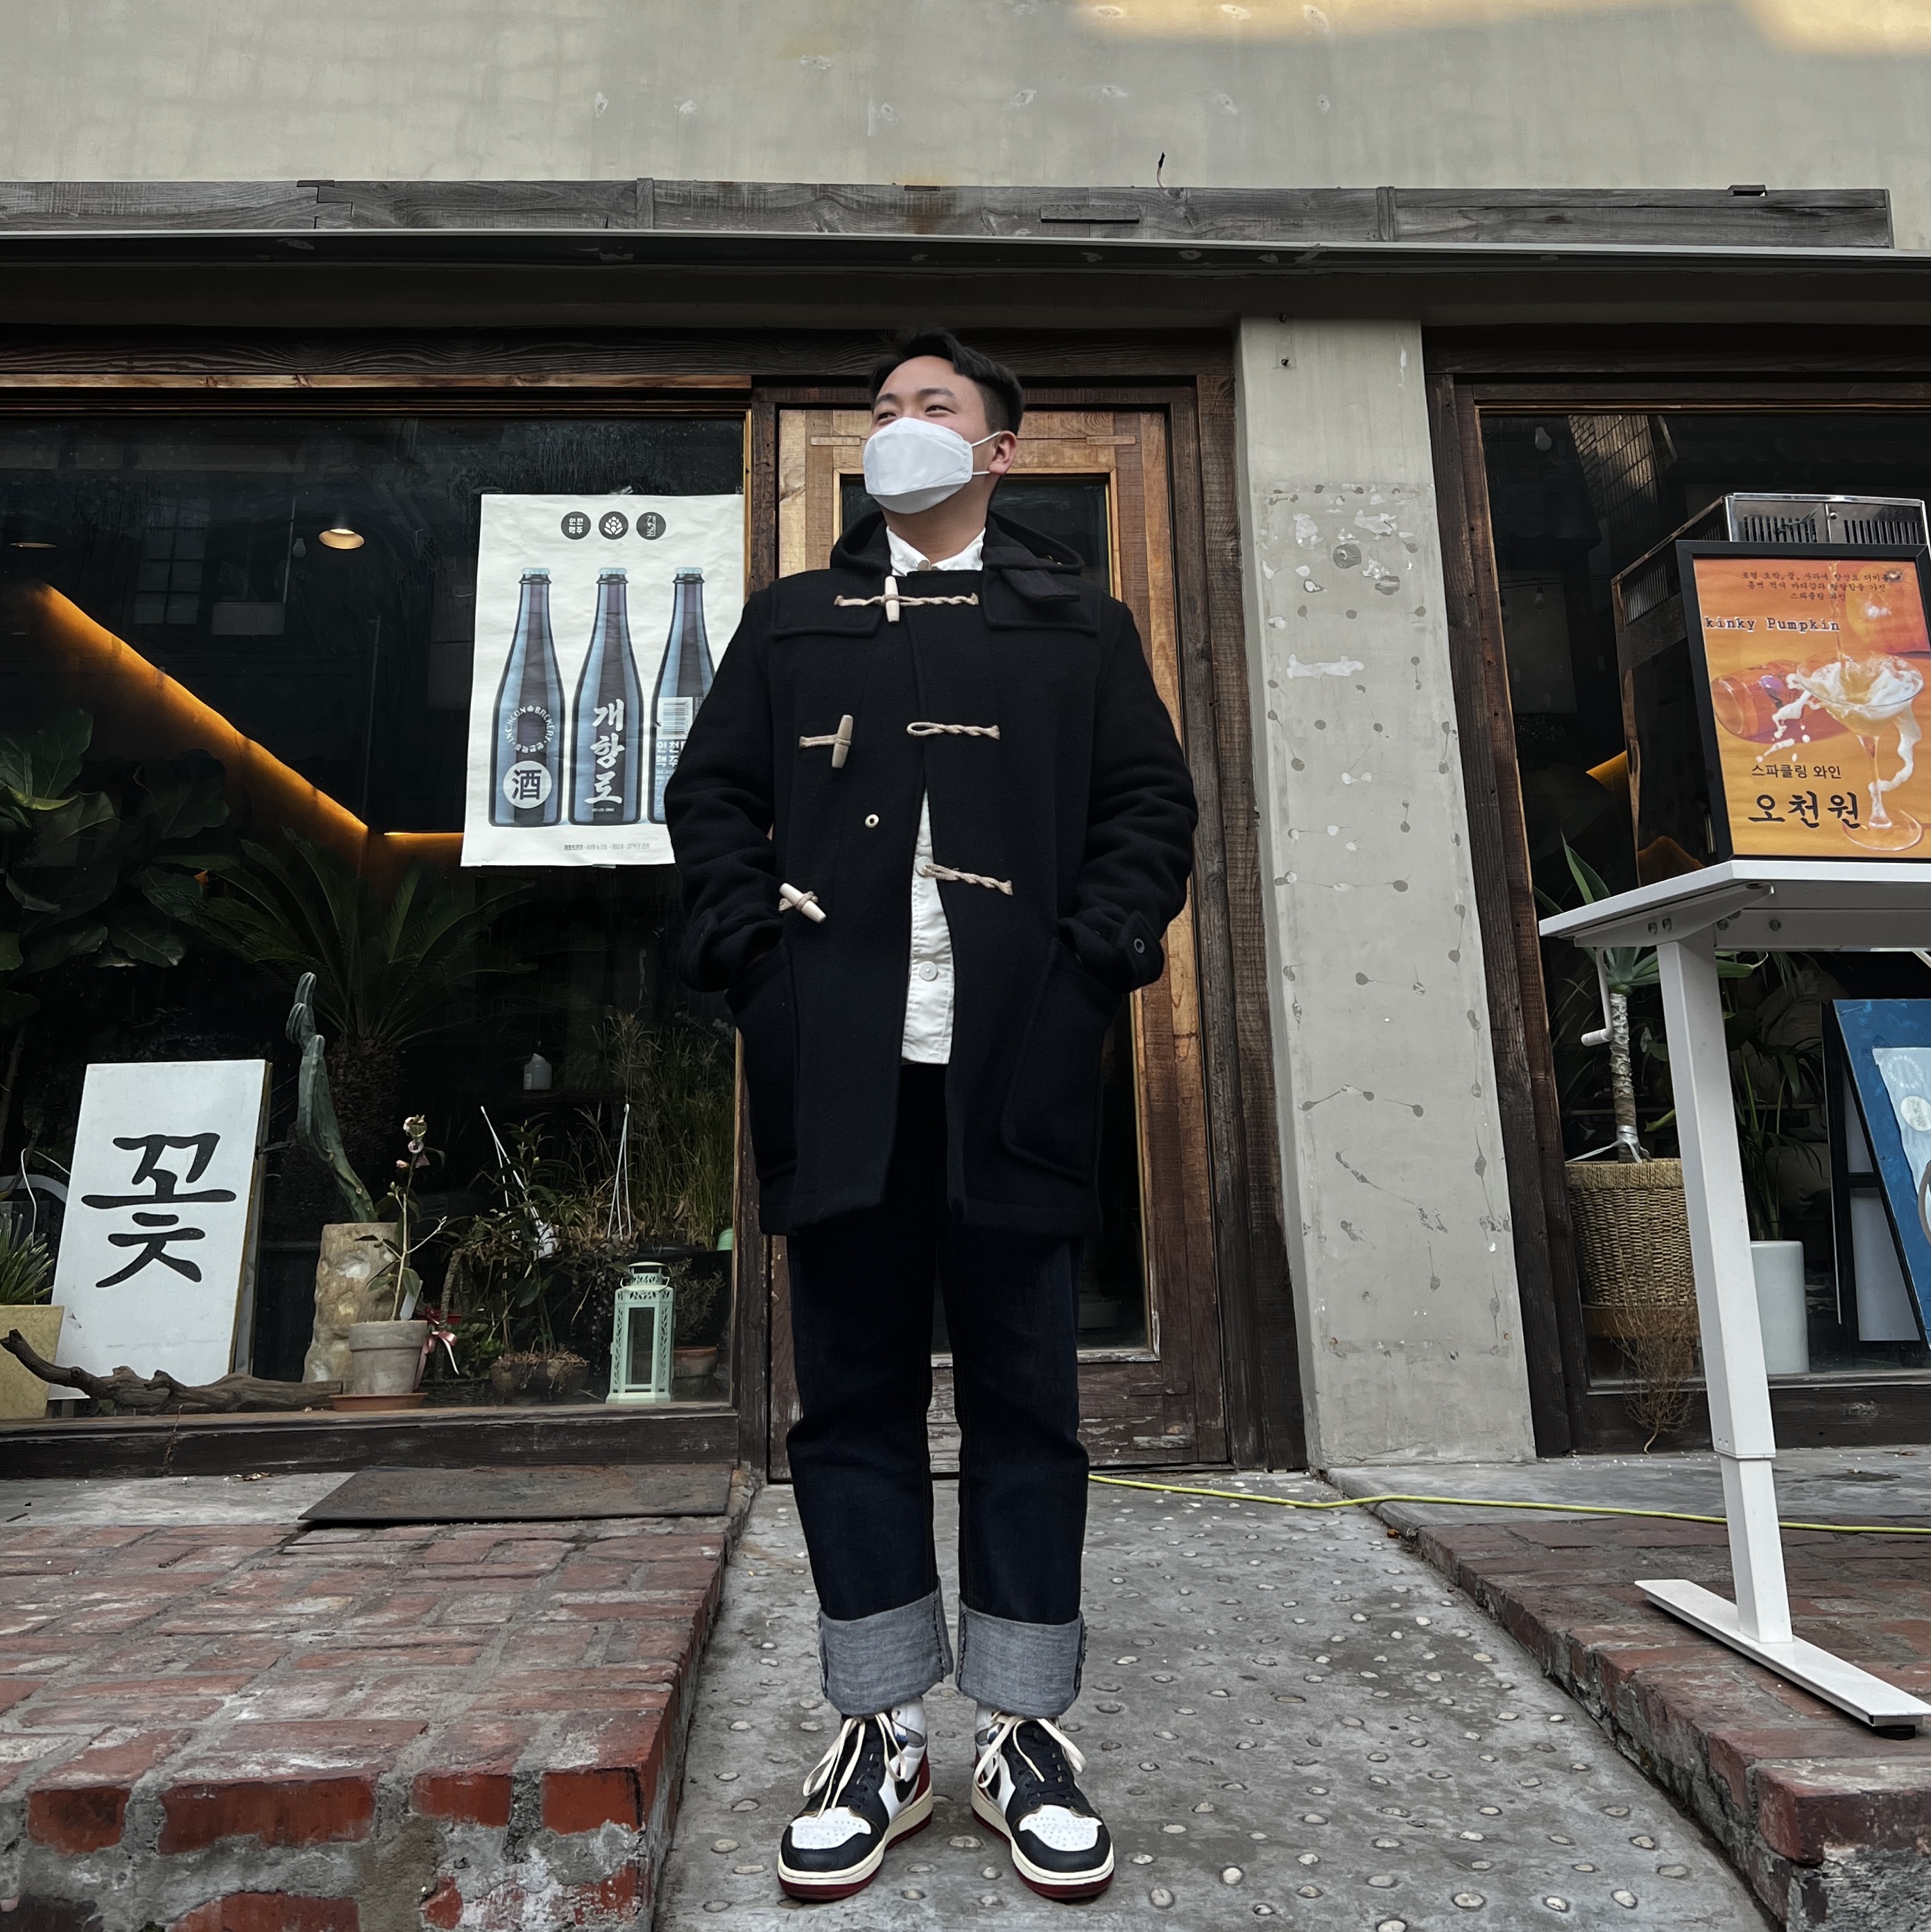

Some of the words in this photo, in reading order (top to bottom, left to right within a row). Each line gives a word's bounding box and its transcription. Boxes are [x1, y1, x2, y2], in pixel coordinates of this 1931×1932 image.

[569, 517, 583, 526] 인천
[1705, 617, 1756, 631] kinky
[1767, 617, 1840, 632] Pumpkin
[505, 706, 526, 743] INCHEON
[584, 699, 625, 804] 개항로
[656, 740, 679, 753] 인천
[512, 769, 542, 800] 酒
[1751, 764, 1808, 779] 스파클링
[1813, 765, 1842, 779] 와인
[1748, 791, 1861, 829] 오천원
[80, 1132, 237, 1288] 꽃
